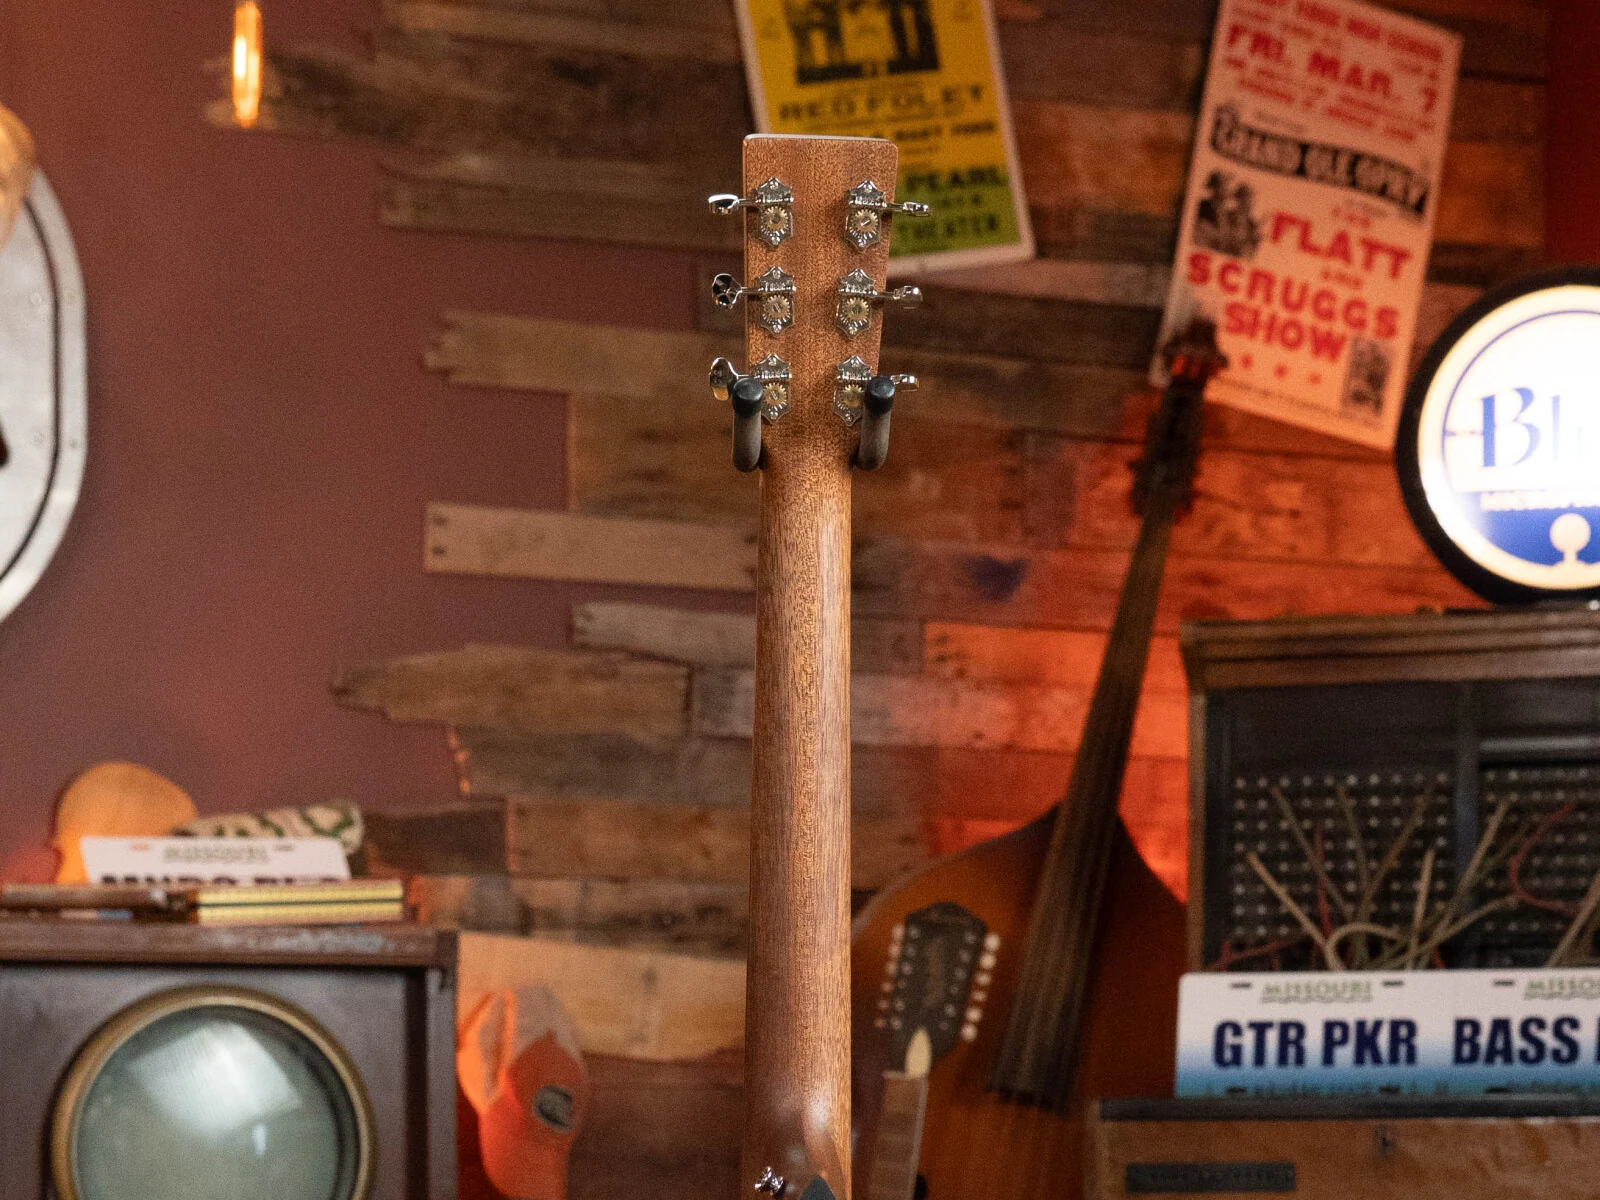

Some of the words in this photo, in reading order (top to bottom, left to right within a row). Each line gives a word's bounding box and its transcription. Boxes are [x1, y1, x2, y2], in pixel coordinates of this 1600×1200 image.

[1270, 210, 1413, 281] FLATT
[1187, 250, 1399, 341] SCRUGGS
[1225, 301, 1348, 364] SHOW
[1262, 979, 1374, 1003] MISSOURI
[1213, 1019, 1305, 1068] GTR
[1322, 1018, 1418, 1067] PKR
[1452, 1015, 1581, 1067] BASS
